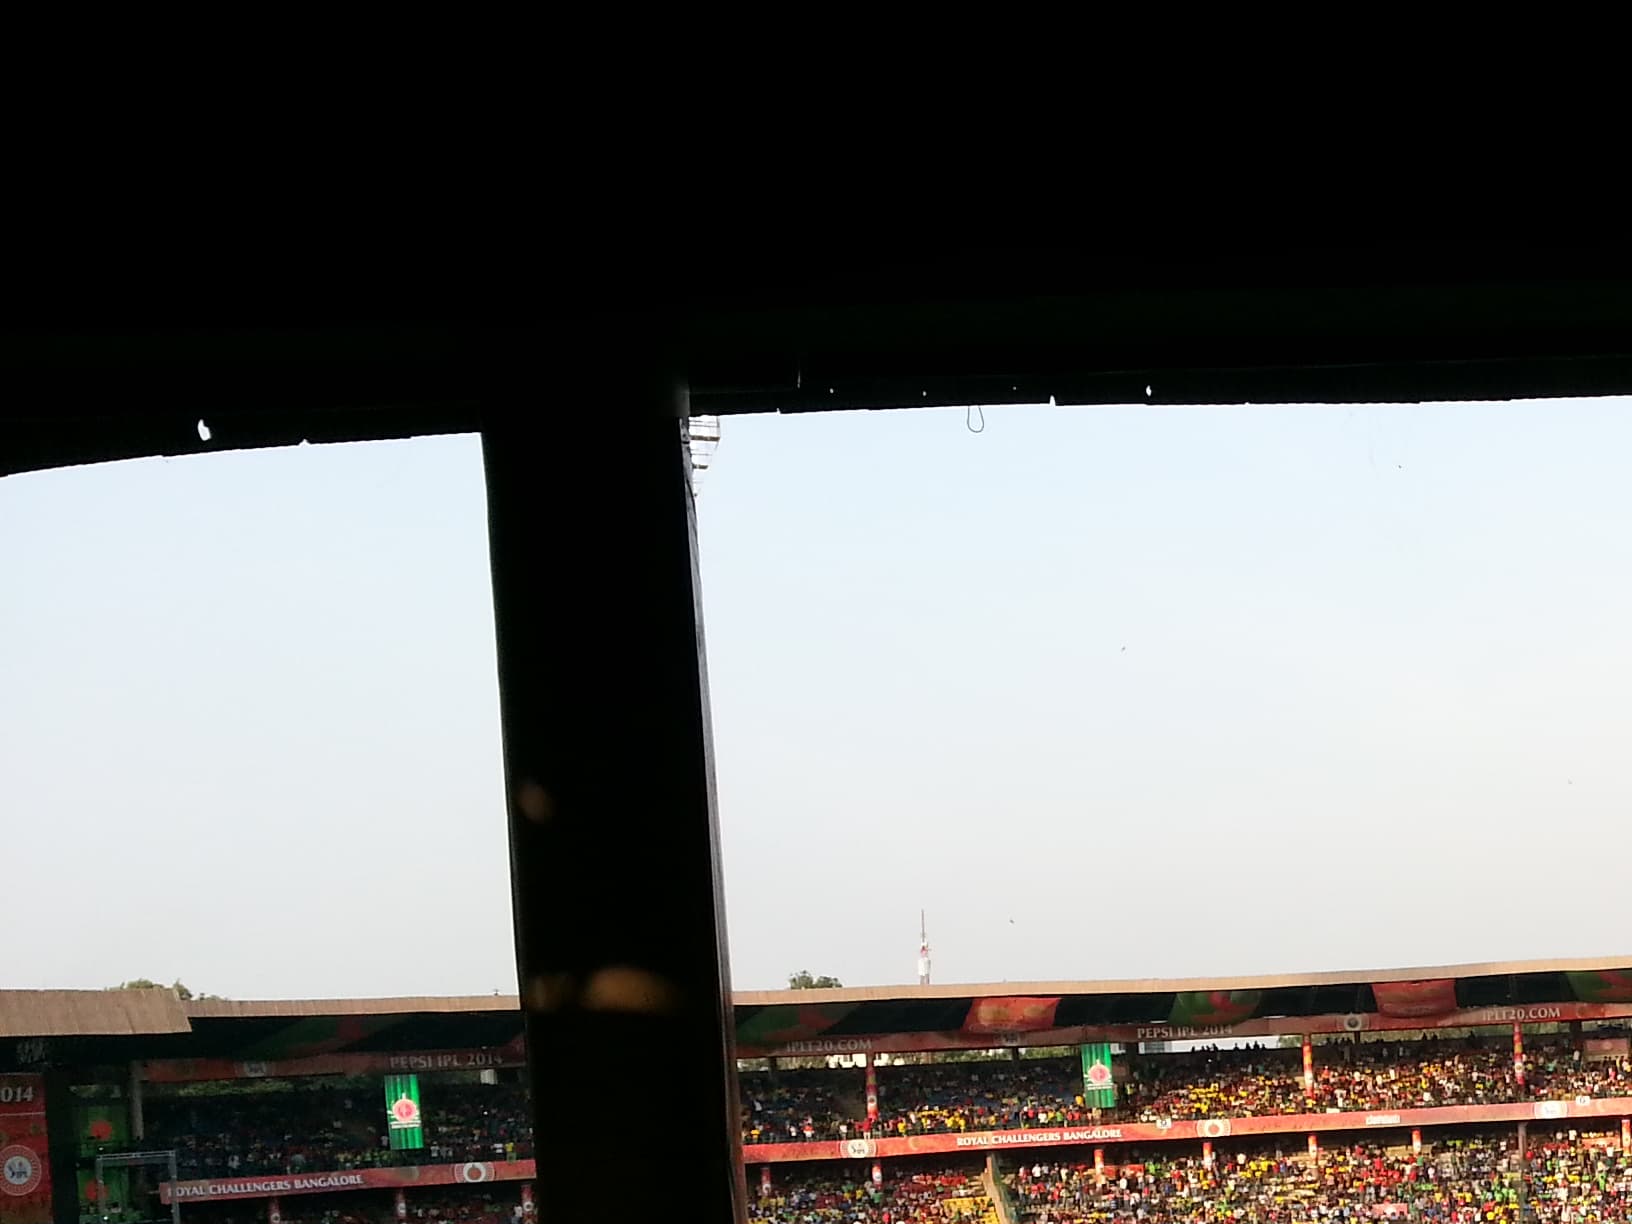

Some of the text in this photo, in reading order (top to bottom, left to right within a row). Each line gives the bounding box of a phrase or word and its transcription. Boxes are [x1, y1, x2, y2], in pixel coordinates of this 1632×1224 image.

[1483, 1007, 1560, 1021] IPLT20.COM
[1137, 1024, 1233, 1038] PEPSI IPL 2014
[787, 1039, 872, 1053] IPLT20.COM
[390, 1053, 503, 1069] PEPSI IPL 2014
[0, 1086, 34, 1102] 014
[957, 1129, 1122, 1146] ROYAL CHALLENGERS BANGALORE
[209, 1181, 291, 1194] CHALLENGERS
[294, 1175, 364, 1189] BANGALORE
